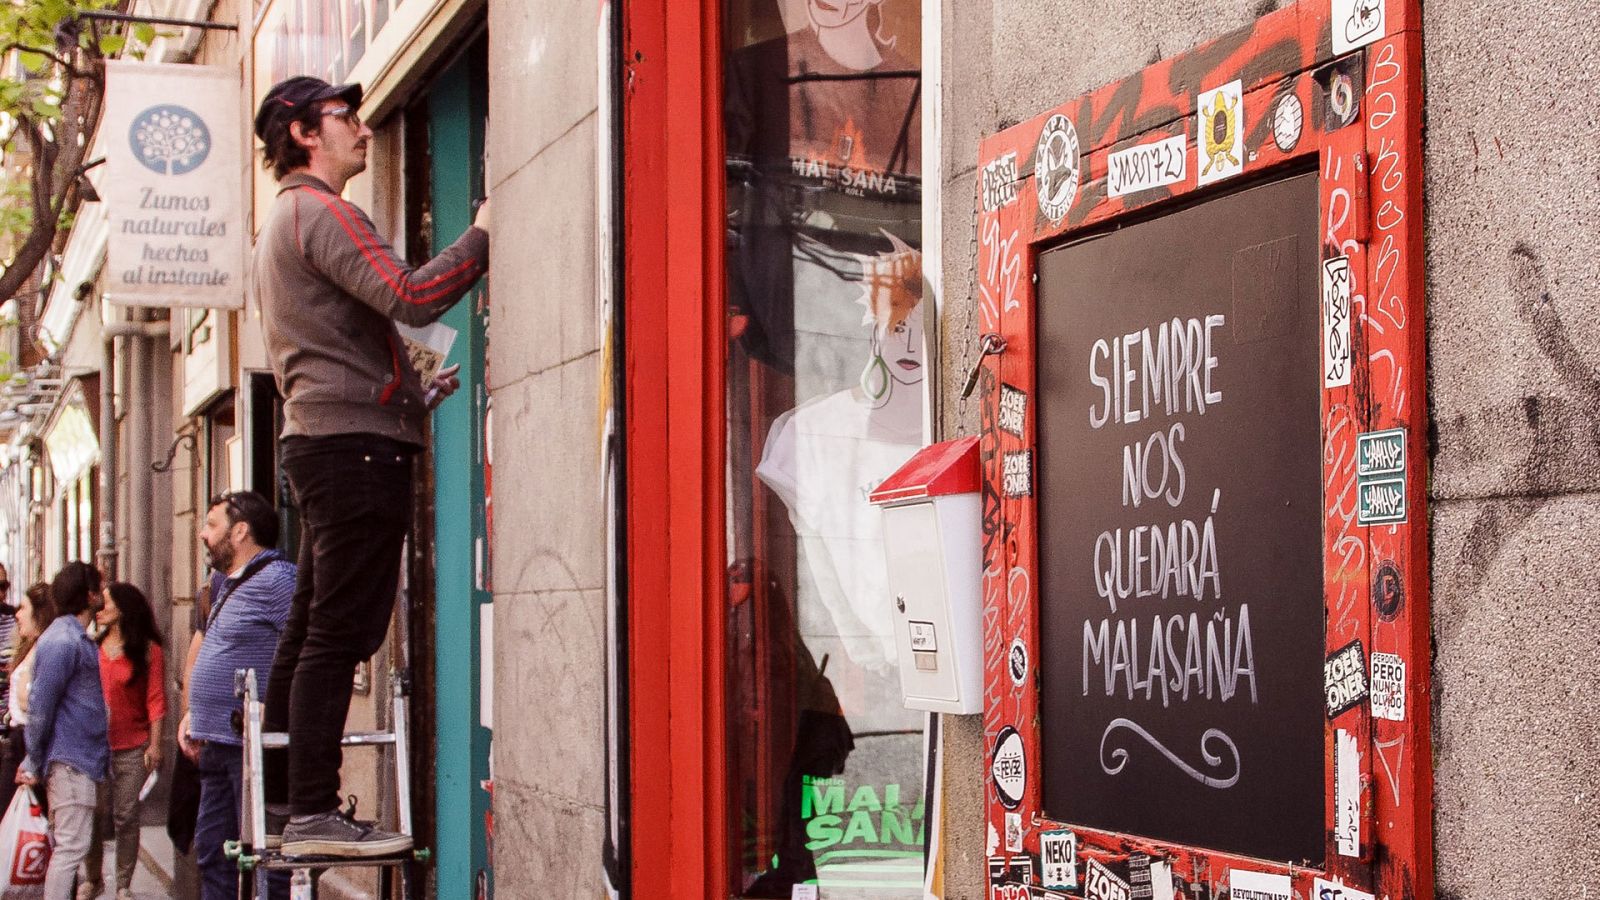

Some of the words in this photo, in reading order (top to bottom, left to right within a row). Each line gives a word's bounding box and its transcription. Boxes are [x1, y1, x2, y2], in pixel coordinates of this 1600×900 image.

[139, 187, 210, 211] Zumos
[121, 216, 226, 236] naturales
[142, 243, 209, 262] hechos
[122, 265, 143, 284] al
[147, 265, 229, 286] instante
[1089, 314, 1225, 429] SIEMPRE
[1122, 422, 1186, 508] NOS
[1094, 488, 1221, 614] QUEDARÁ
[1082, 603, 1258, 708] MALASAÑA
[1324, 646, 1362, 688] ZOER
[1373, 663, 1402, 682] PERO
[1373, 680, 1401, 695] NUNCA
[1327, 671, 1365, 709] ONER
[804, 809, 925, 851] SAN
[1045, 839, 1072, 864] NEKO
